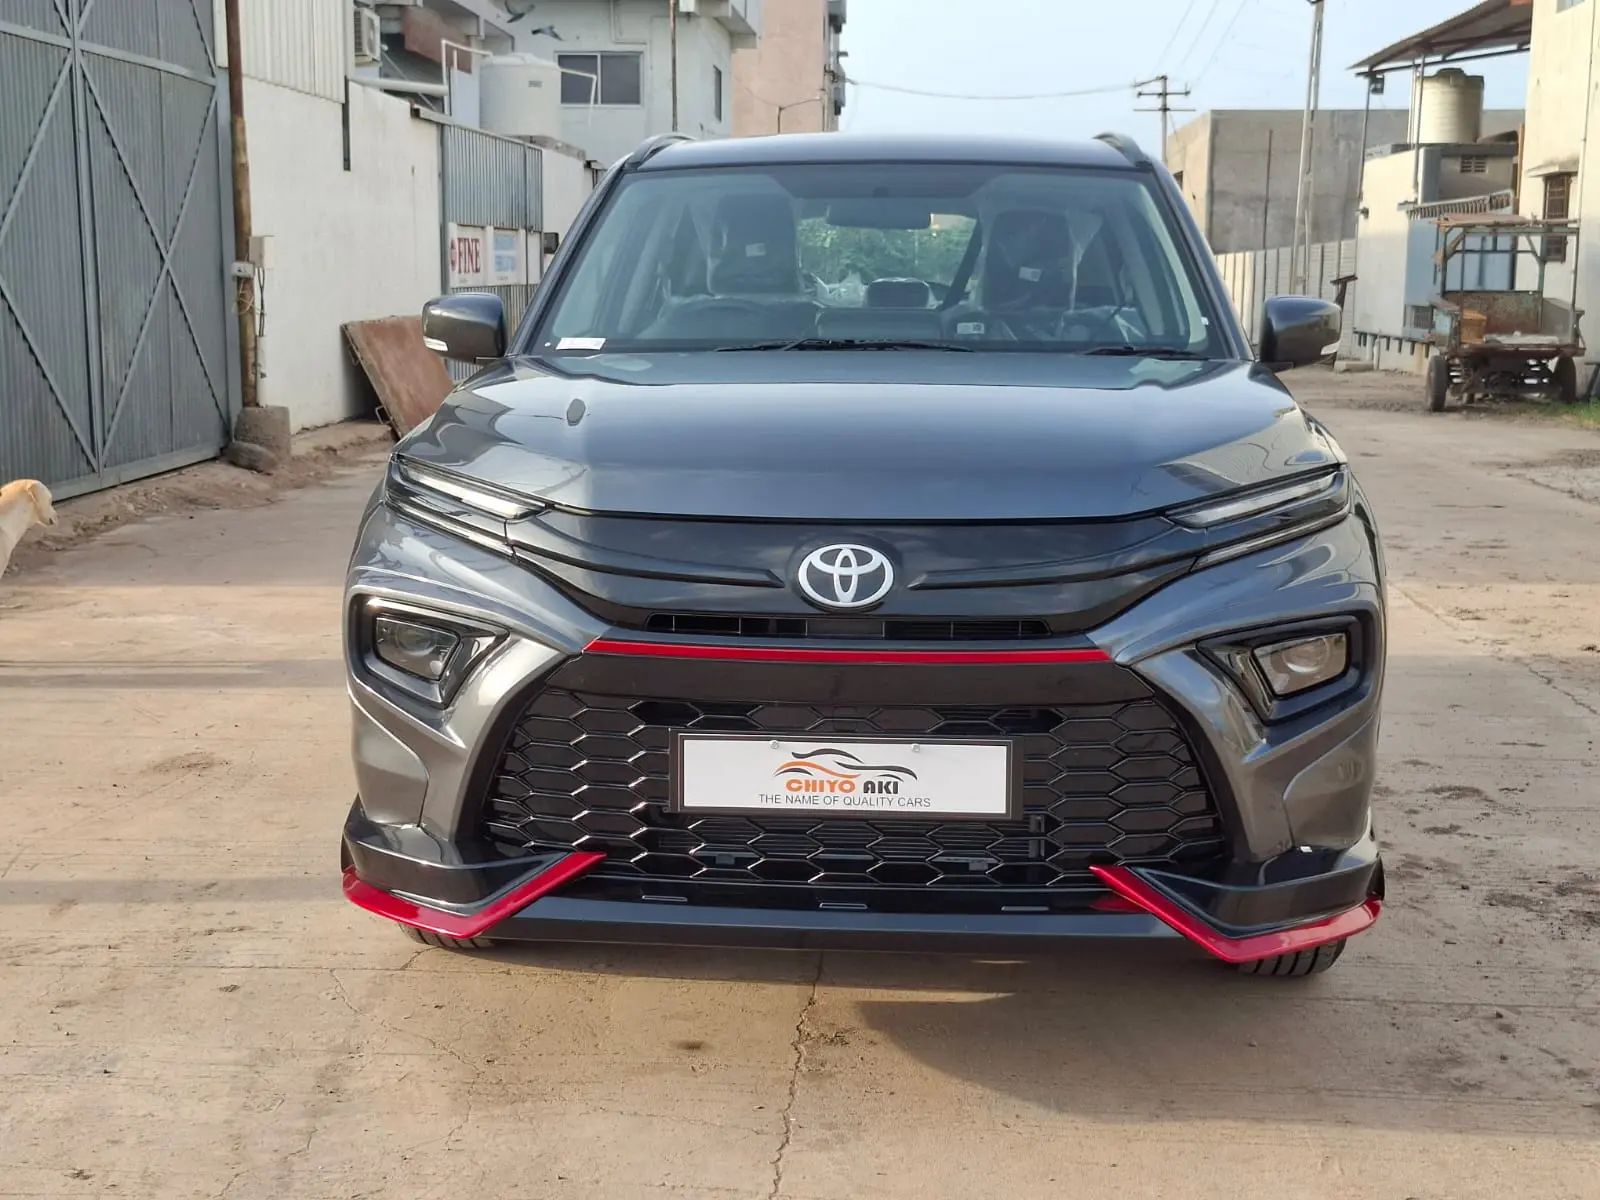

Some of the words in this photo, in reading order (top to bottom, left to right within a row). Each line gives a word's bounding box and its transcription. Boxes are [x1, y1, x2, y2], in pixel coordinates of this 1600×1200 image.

[457, 237, 481, 274] FINE
[785, 778, 856, 794] CHIYO
[863, 780, 899, 794] AKI
[758, 793, 781, 804] THE
[785, 794, 819, 805] NAME
[823, 795, 840, 806] OF
[843, 795, 894, 807] QUALITY
[897, 797, 931, 808] CARS
